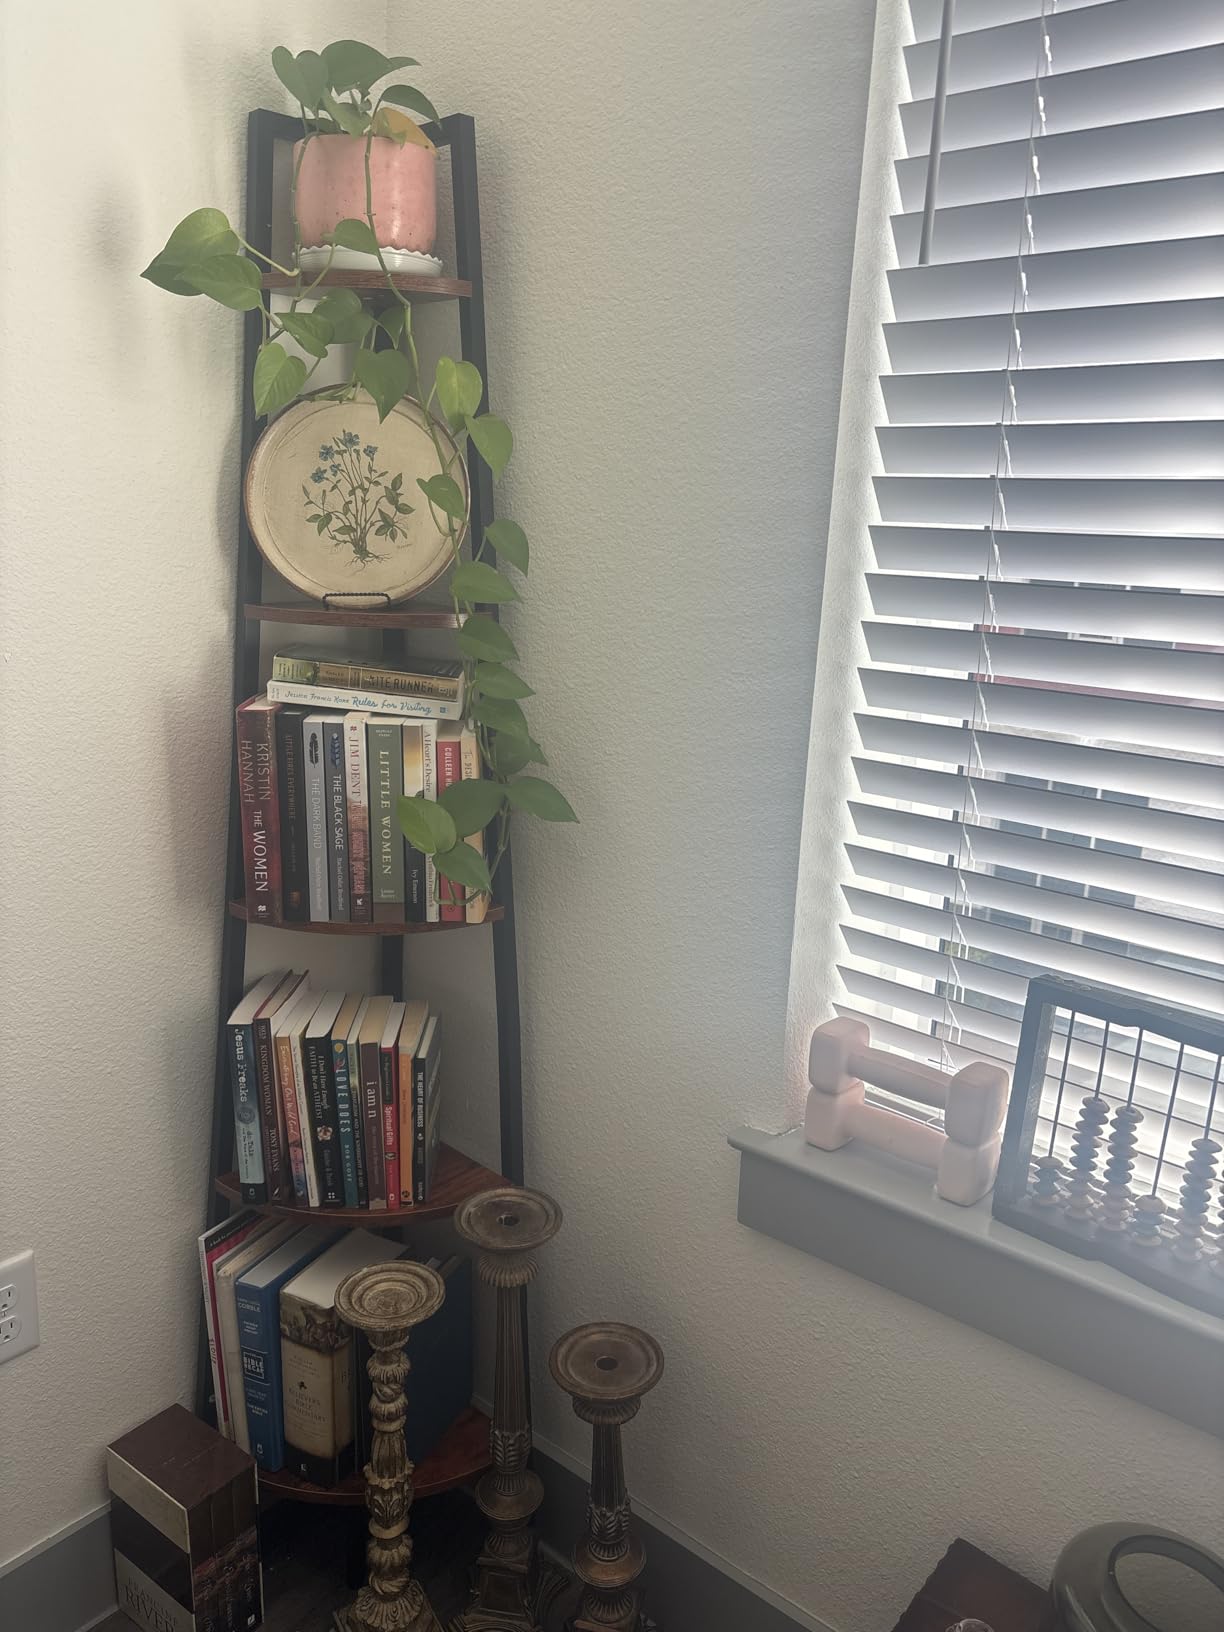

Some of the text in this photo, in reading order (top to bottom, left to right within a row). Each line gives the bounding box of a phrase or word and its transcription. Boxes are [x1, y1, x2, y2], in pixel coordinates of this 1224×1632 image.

[351, 695, 379, 708] Rules
[400, 702, 432, 714] Visiting
[240, 740, 255, 803] HANNAH
[255, 742, 272, 801] KRISTIN
[348, 736, 362, 798] JIM DENT
[424, 738, 433, 768] Heart's
[444, 747, 453, 776] COLLEEN
[378, 750, 391, 809] LITTLE
[424, 769, 433, 793] Desire
[310, 777, 322, 849] THE DARK BAND
[332, 774, 344, 850] THE BLACK SAGE
[252, 809, 269, 892] THE WOMEN
[381, 815, 392, 875] WOMEN
[410, 869, 418, 879] Ivy
[234, 1028, 249, 1103] Jesus Freaks
[260, 1044, 270, 1083] KINGDOM
[261, 1083, 273, 1116] WOMAN
[313, 1090, 323, 1119] ATHEIST
[335, 1068, 351, 1134] LOVE DOES
[367, 1088, 377, 1107] am
[417, 1097, 424, 1105] OF
[269, 1128, 278, 1148] TONY
[383, 1106, 395, 1146] Spiritual Gifts
[343, 1144, 351, 1160] BOB
[243, 1355, 265, 1369] BIBLE
[123, 1584, 176, 1632] RIVER
